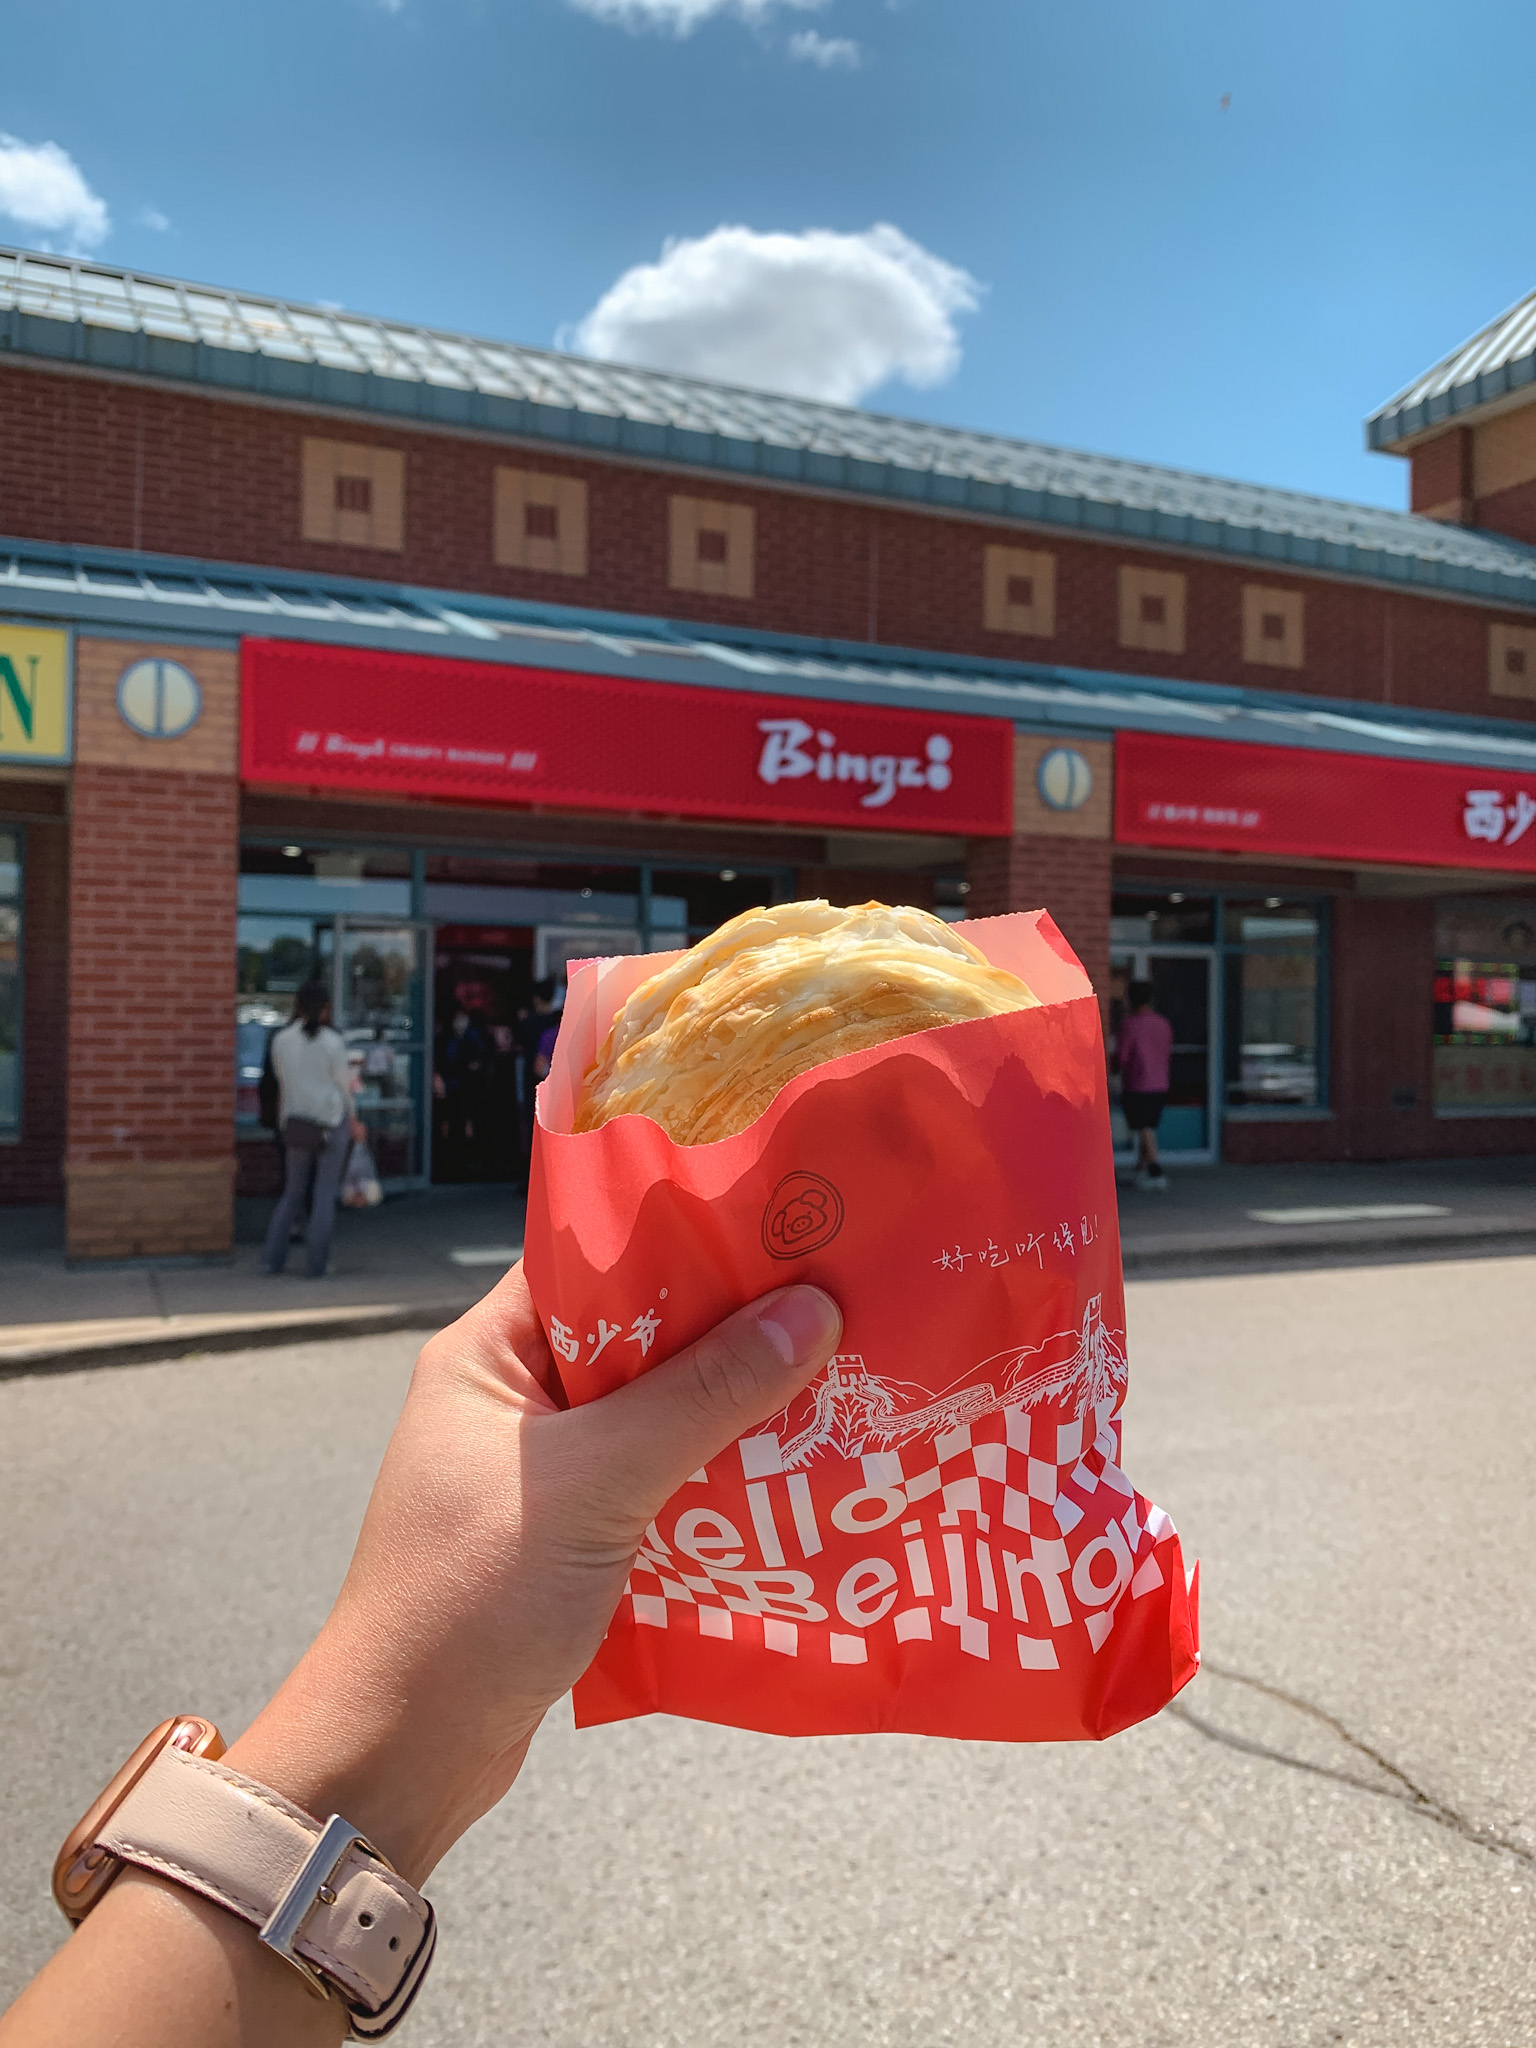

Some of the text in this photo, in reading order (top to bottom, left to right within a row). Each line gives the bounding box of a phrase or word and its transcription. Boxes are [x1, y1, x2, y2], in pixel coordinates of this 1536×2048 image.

[550, 1308, 663, 1366] 西少爷
[645, 1474, 908, 1569] ello
[699, 1508, 1135, 1655] Beijing
